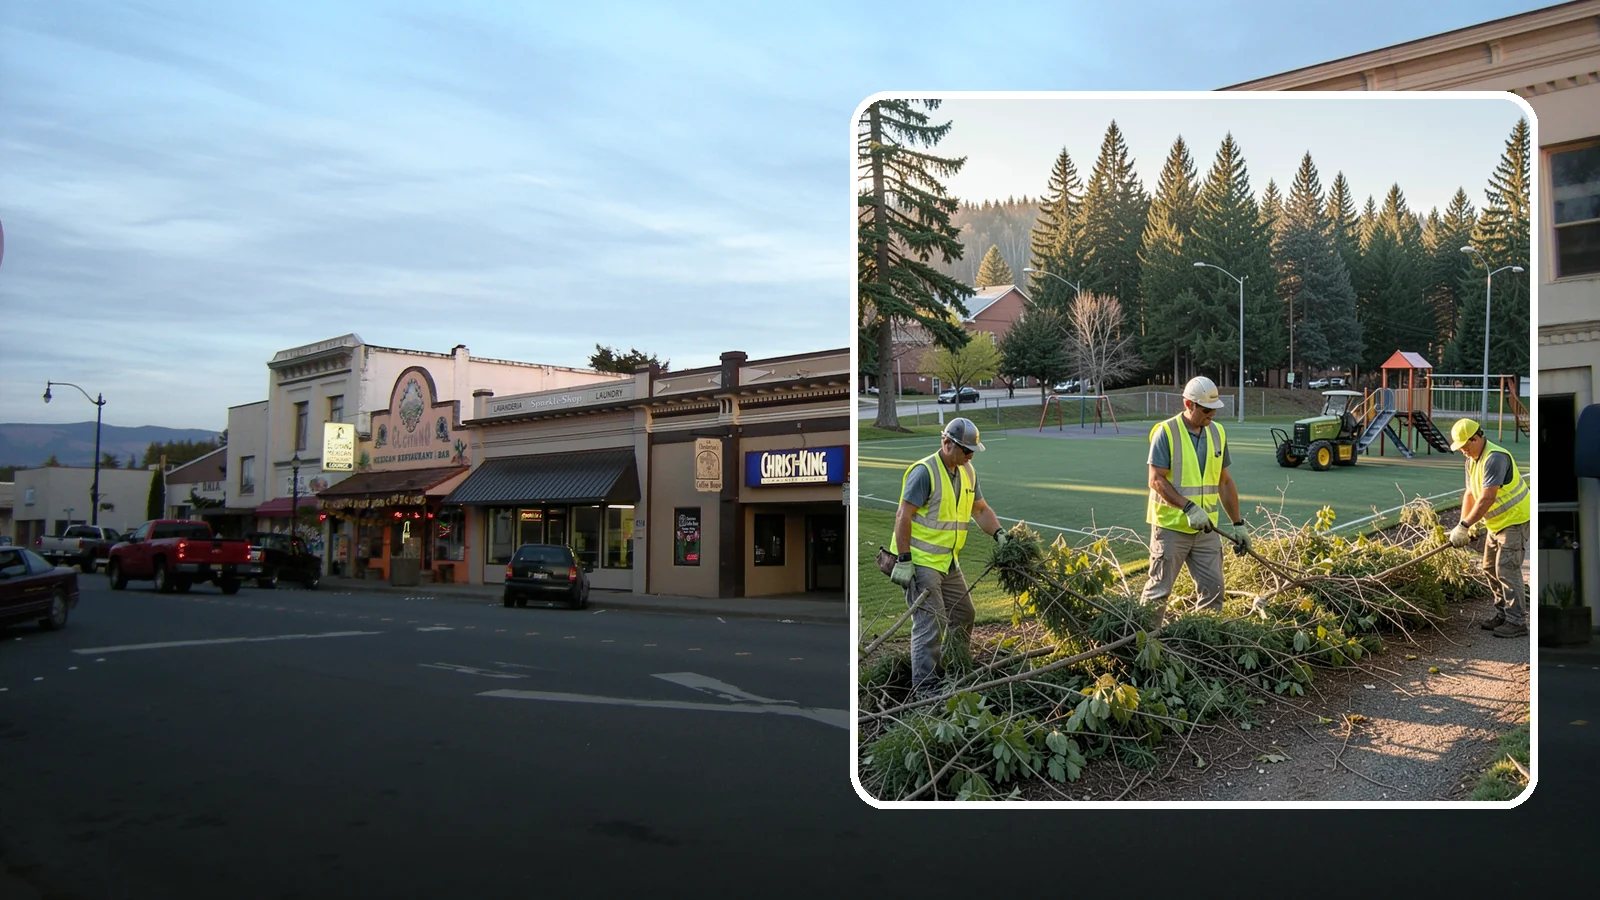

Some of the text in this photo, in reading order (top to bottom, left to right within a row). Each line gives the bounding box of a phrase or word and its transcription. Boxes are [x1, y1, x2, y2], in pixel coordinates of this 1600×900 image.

[562, 394, 582, 404] Shop
[595, 389, 623, 400] LAUNDRY
[493, 402, 522, 412] LAVANDERIA
[374, 450, 450, 464] MEXICAN RESTAURANT BAR
[761, 450, 827, 478] CHRIST KING
[696, 480, 722, 489] Coffee House
